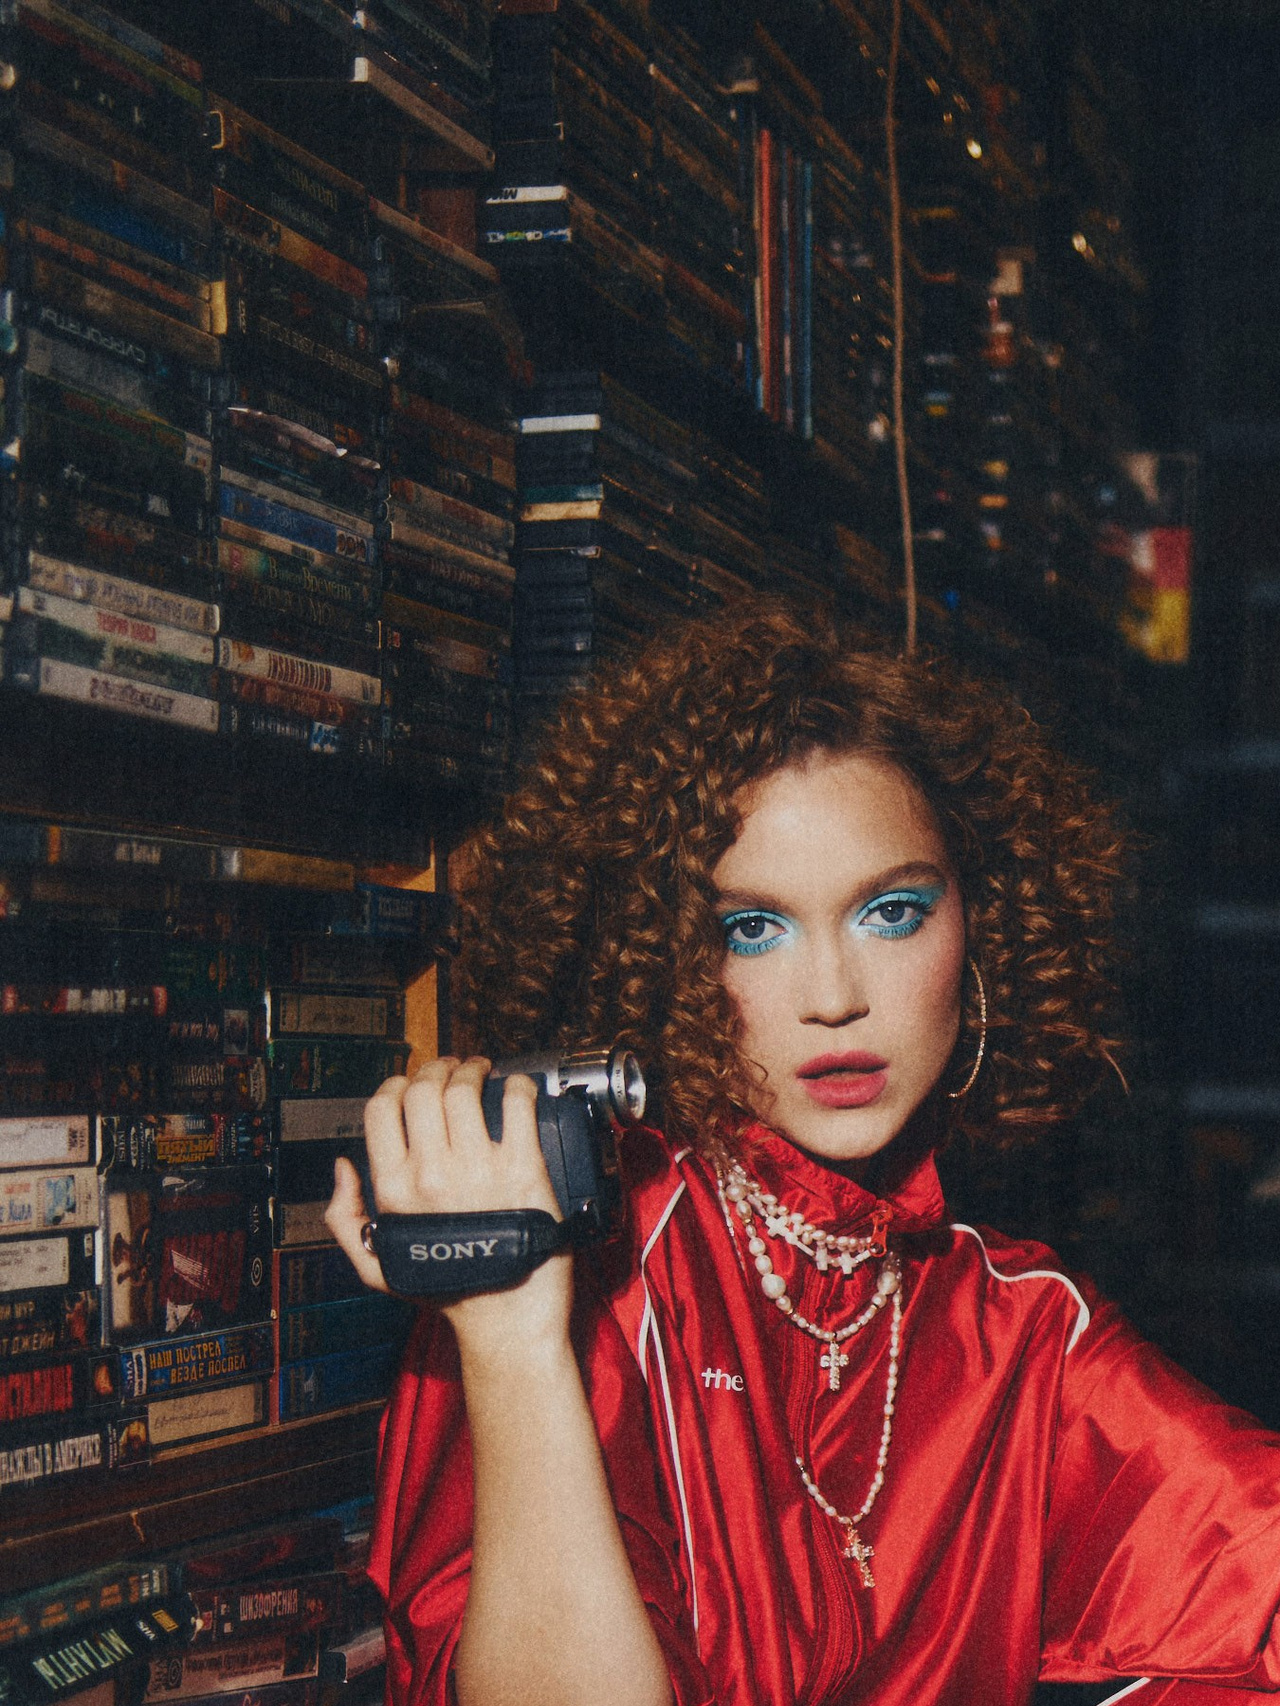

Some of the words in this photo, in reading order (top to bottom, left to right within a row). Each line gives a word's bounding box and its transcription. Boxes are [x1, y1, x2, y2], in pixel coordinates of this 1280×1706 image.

[409, 1239, 499, 1262] SONY
[10, 1325, 56, 1357] ДЖЕЙН
[148, 1349, 173, 1370] НАШ
[175, 1340, 222, 1365] ПОСТРЕЛ
[169, 1361, 205, 1385] ВЕЗДЕ
[207, 1353, 248, 1377] ПОСПЕЛ
[700, 1366, 745, 1391] the
[54, 1432, 102, 1474] АМЕРИКЕ
[238, 1588, 299, 1622] ШИЗОФРЕНИЯ
[33, 1628, 134, 1690] МУТАНТЫ
